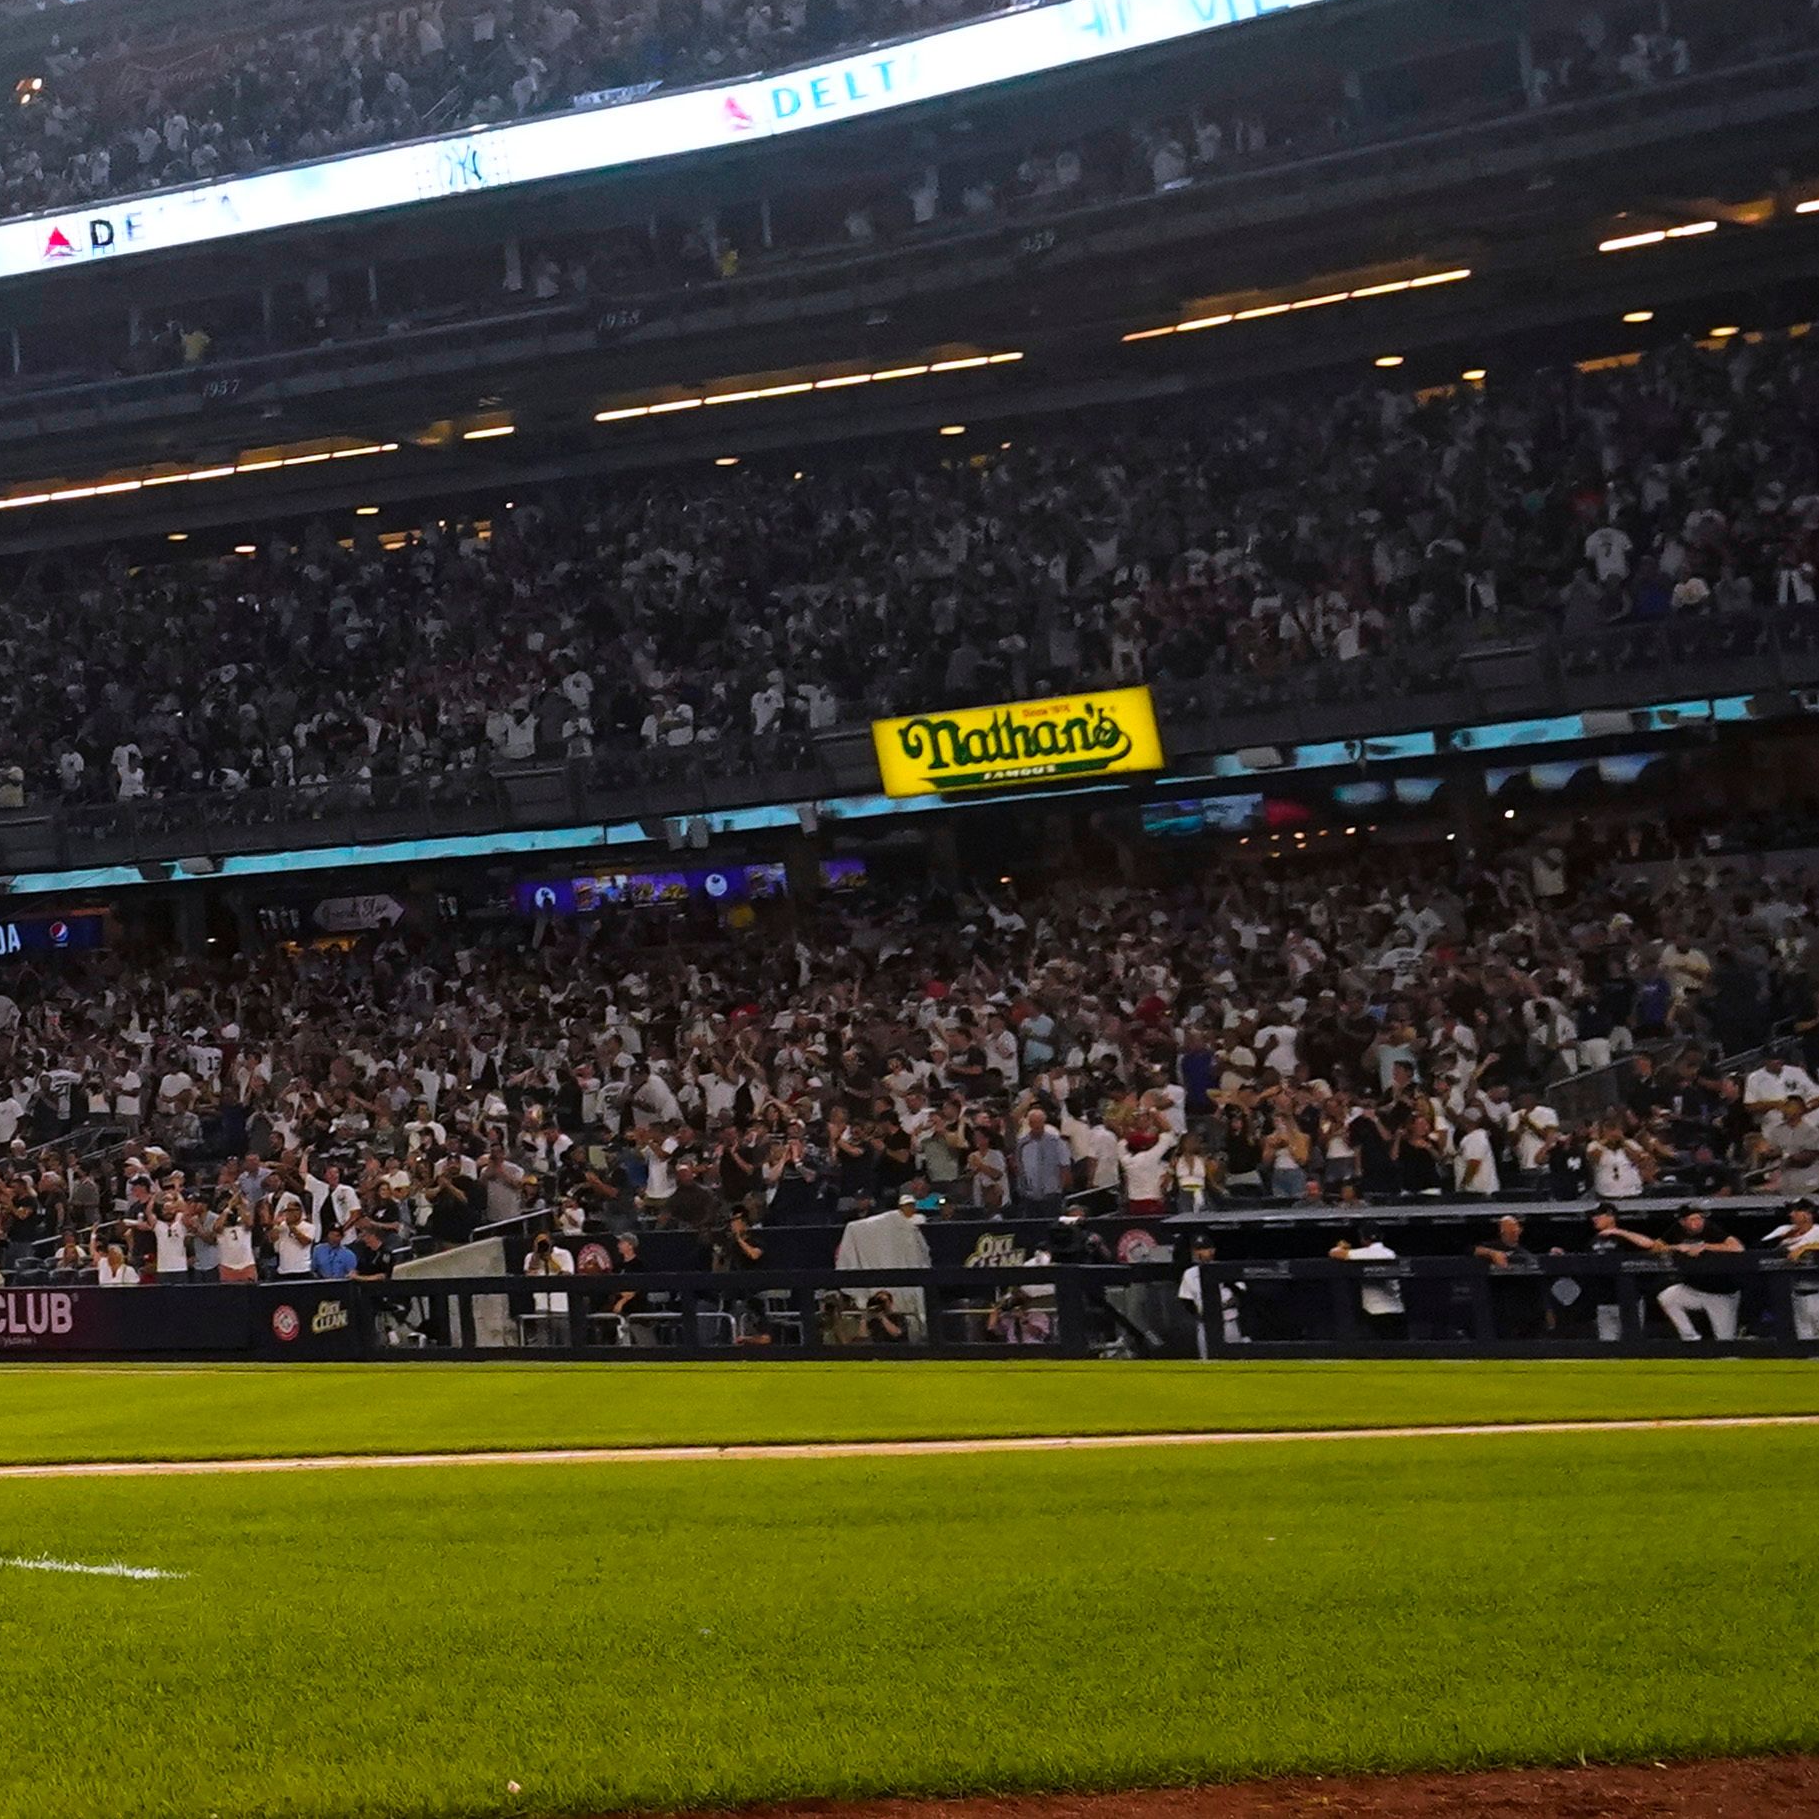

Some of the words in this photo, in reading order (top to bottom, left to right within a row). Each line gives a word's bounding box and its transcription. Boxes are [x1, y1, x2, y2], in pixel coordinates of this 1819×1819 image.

[772, 52, 918, 118] DELT
[898, 703, 1130, 770] Nathan's
[983, 765, 1057, 780] FAMOUS
